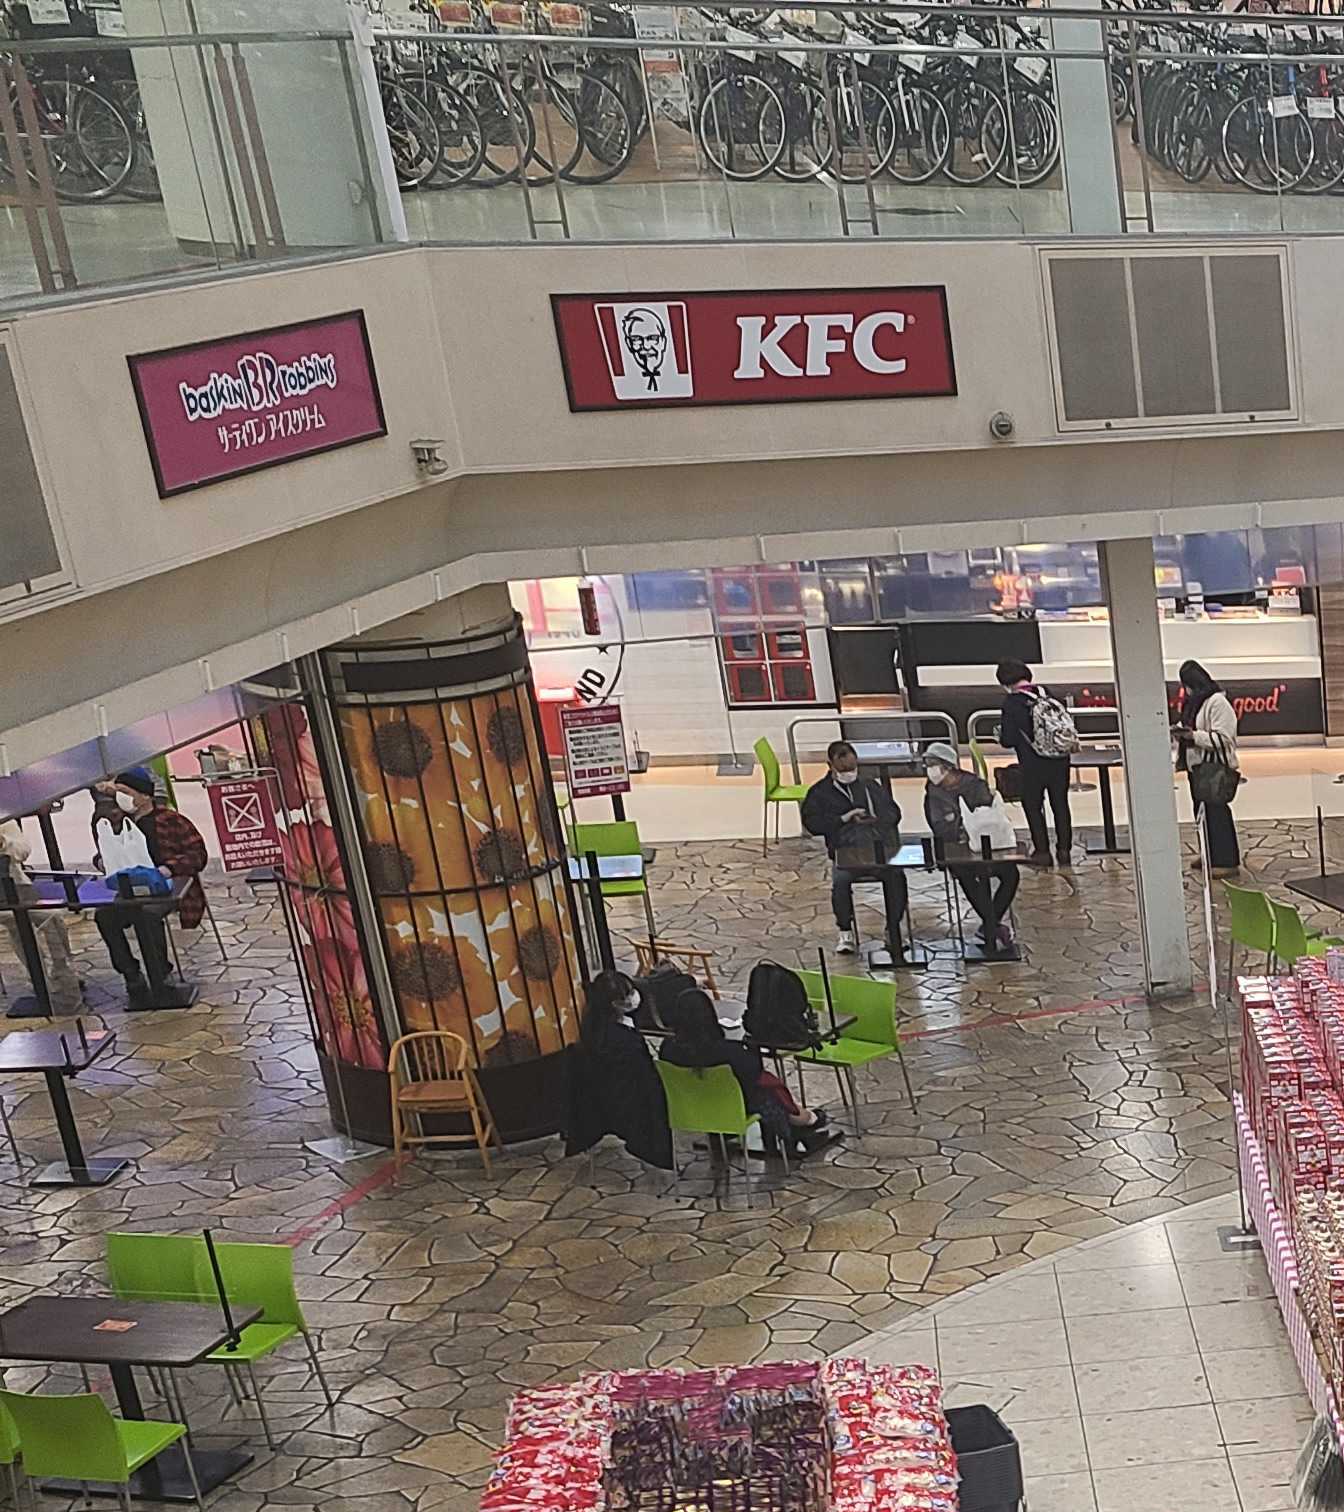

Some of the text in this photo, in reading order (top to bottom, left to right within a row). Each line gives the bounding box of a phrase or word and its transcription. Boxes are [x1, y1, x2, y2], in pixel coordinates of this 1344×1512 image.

[733, 311, 907, 378] KFC
[183, 372, 243, 419] baskin
[279, 353, 336, 397] robbins
[217, 403, 326, 452] サーティワン アイスクリーム
